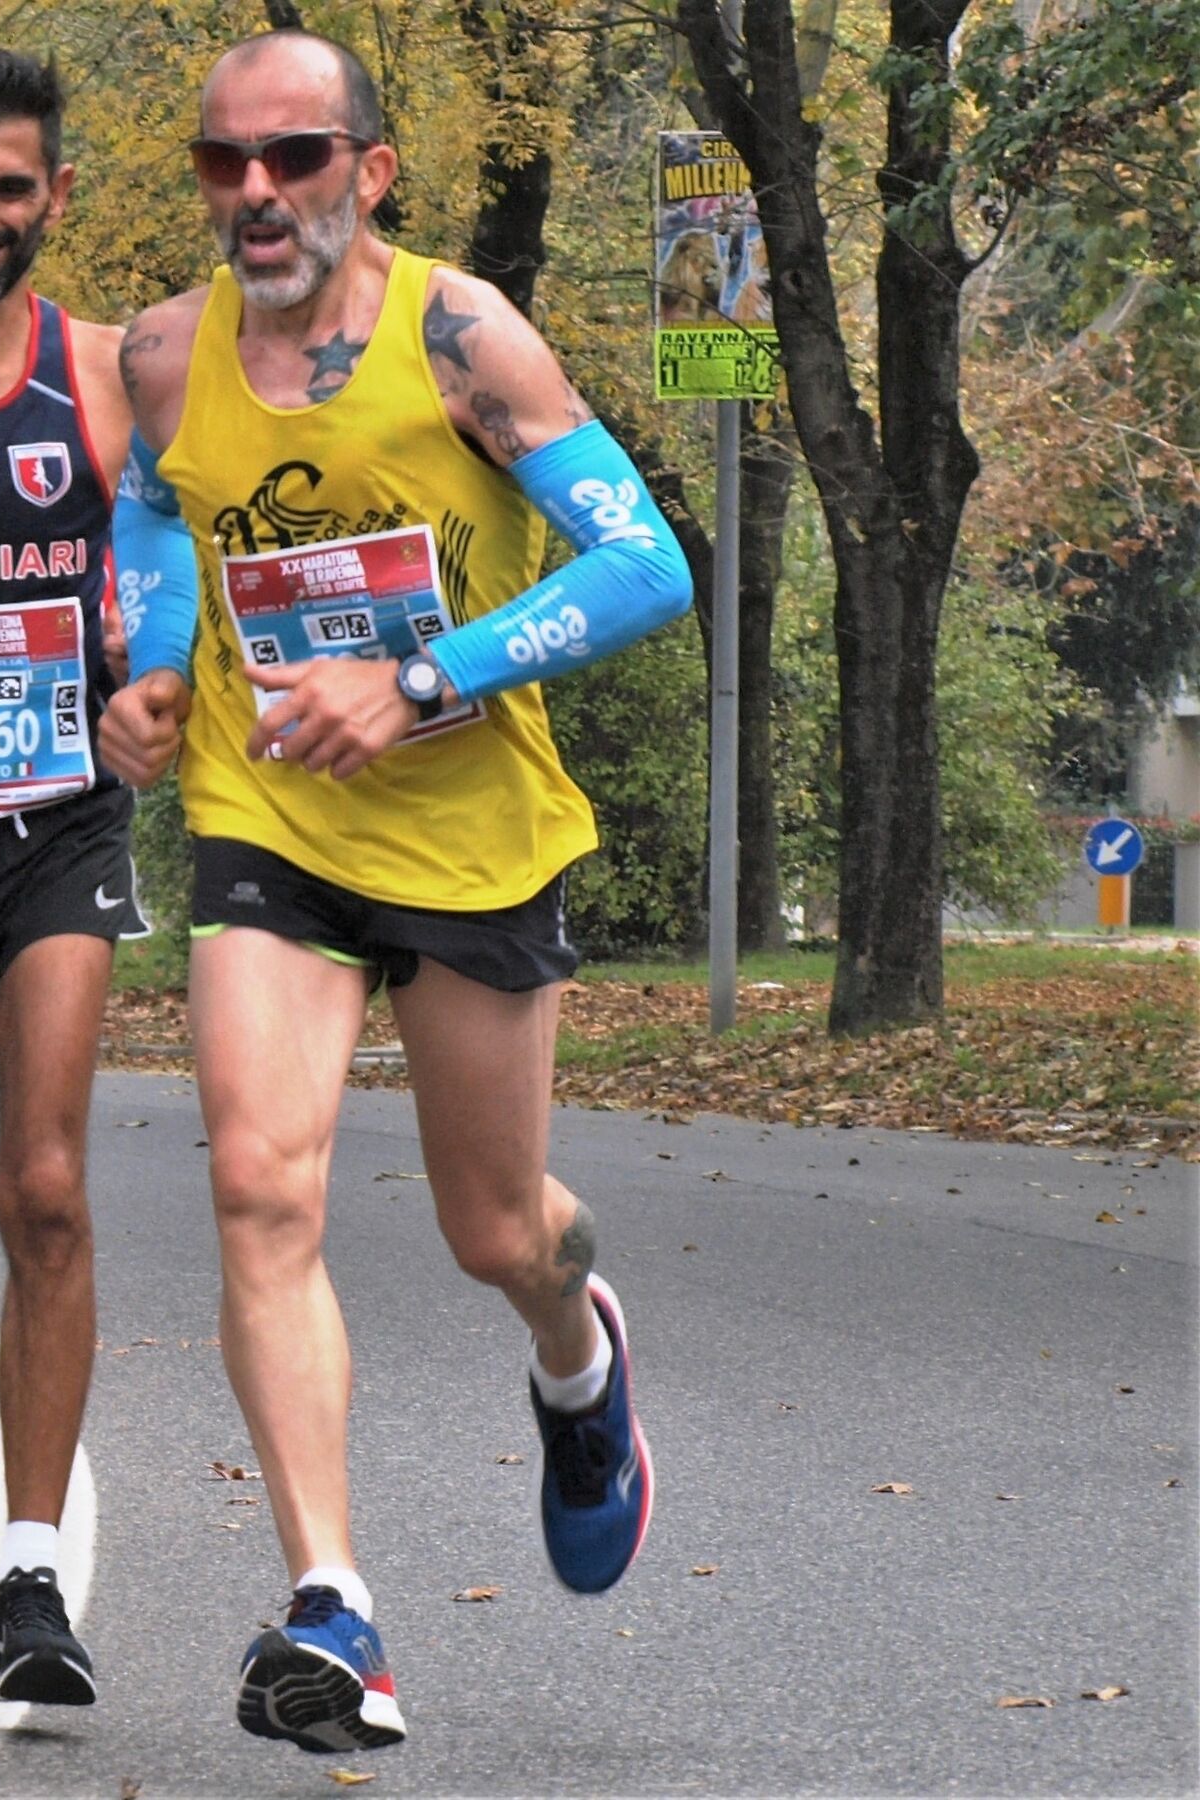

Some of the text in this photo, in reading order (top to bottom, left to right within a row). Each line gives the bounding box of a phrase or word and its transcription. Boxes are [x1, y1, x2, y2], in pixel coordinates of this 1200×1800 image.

[662, 333, 751, 344] RAVENNA
[570, 478, 657, 549] eol
[280, 549, 361, 575] XX MARATONA
[317, 563, 366, 583] RAVENNA
[506, 605, 588, 664] eolo
